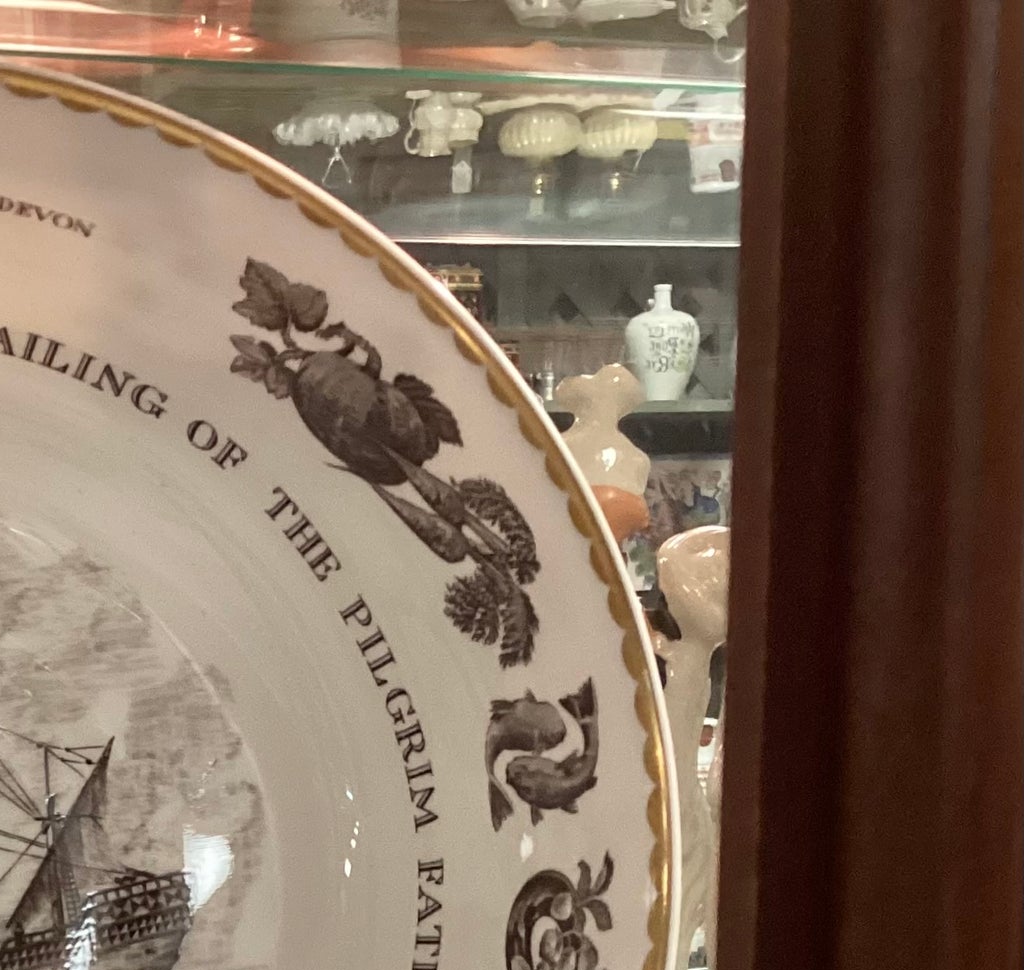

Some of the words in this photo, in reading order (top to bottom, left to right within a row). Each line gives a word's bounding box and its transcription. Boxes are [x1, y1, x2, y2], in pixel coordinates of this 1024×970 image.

[186, 418, 248, 471] OF
[264, 486, 342, 583] THE
[338, 592, 439, 834] PILGRIM
